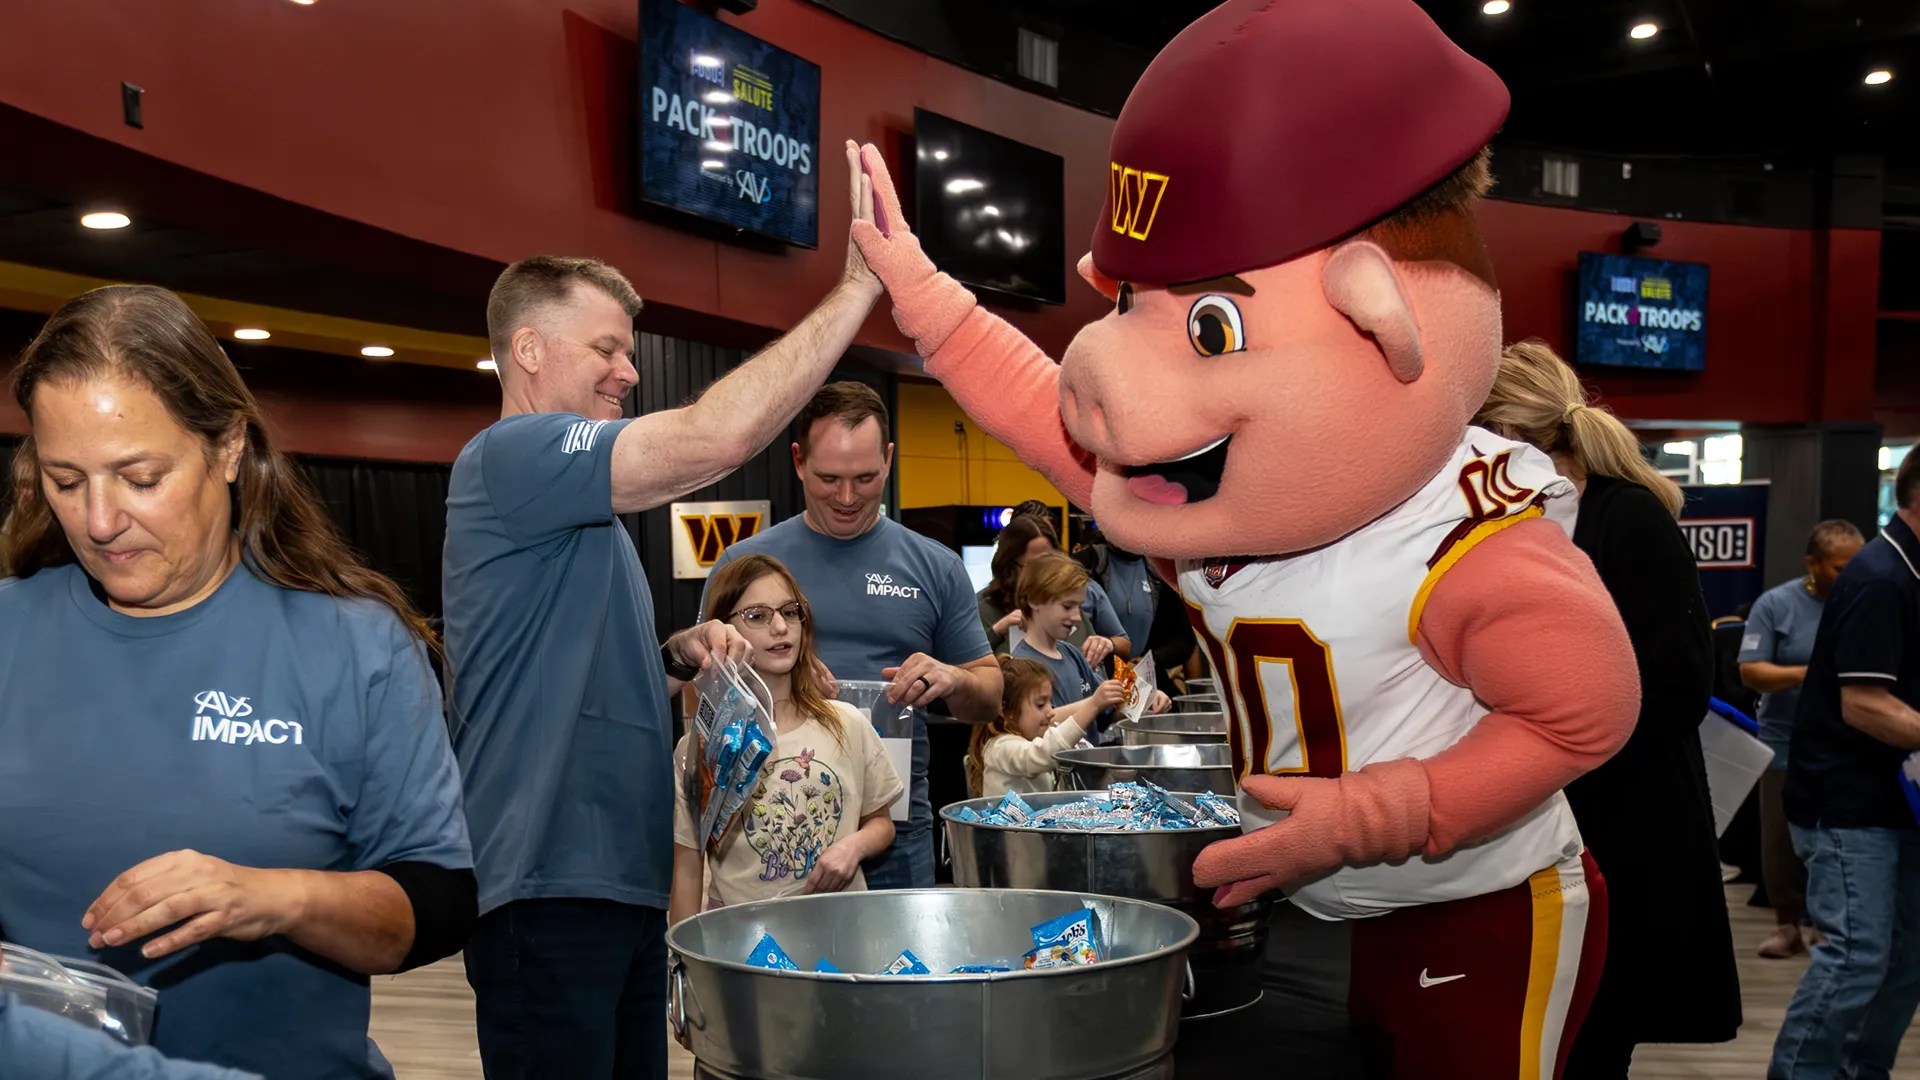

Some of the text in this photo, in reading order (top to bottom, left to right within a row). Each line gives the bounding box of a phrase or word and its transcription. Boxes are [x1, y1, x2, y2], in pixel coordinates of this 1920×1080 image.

[733, 78, 773, 111] SALUTE
[652, 86, 716, 141] PACK
[729, 115, 811, 175] TROOPS
[1111, 161, 1169, 241] W
[1585, 301, 1629, 325] PACK
[1637, 305, 1702, 331] TROOPS
[680, 512, 763, 567] W
[867, 584, 920, 599] IMPACT
[192, 716, 303, 745] IMPACT
